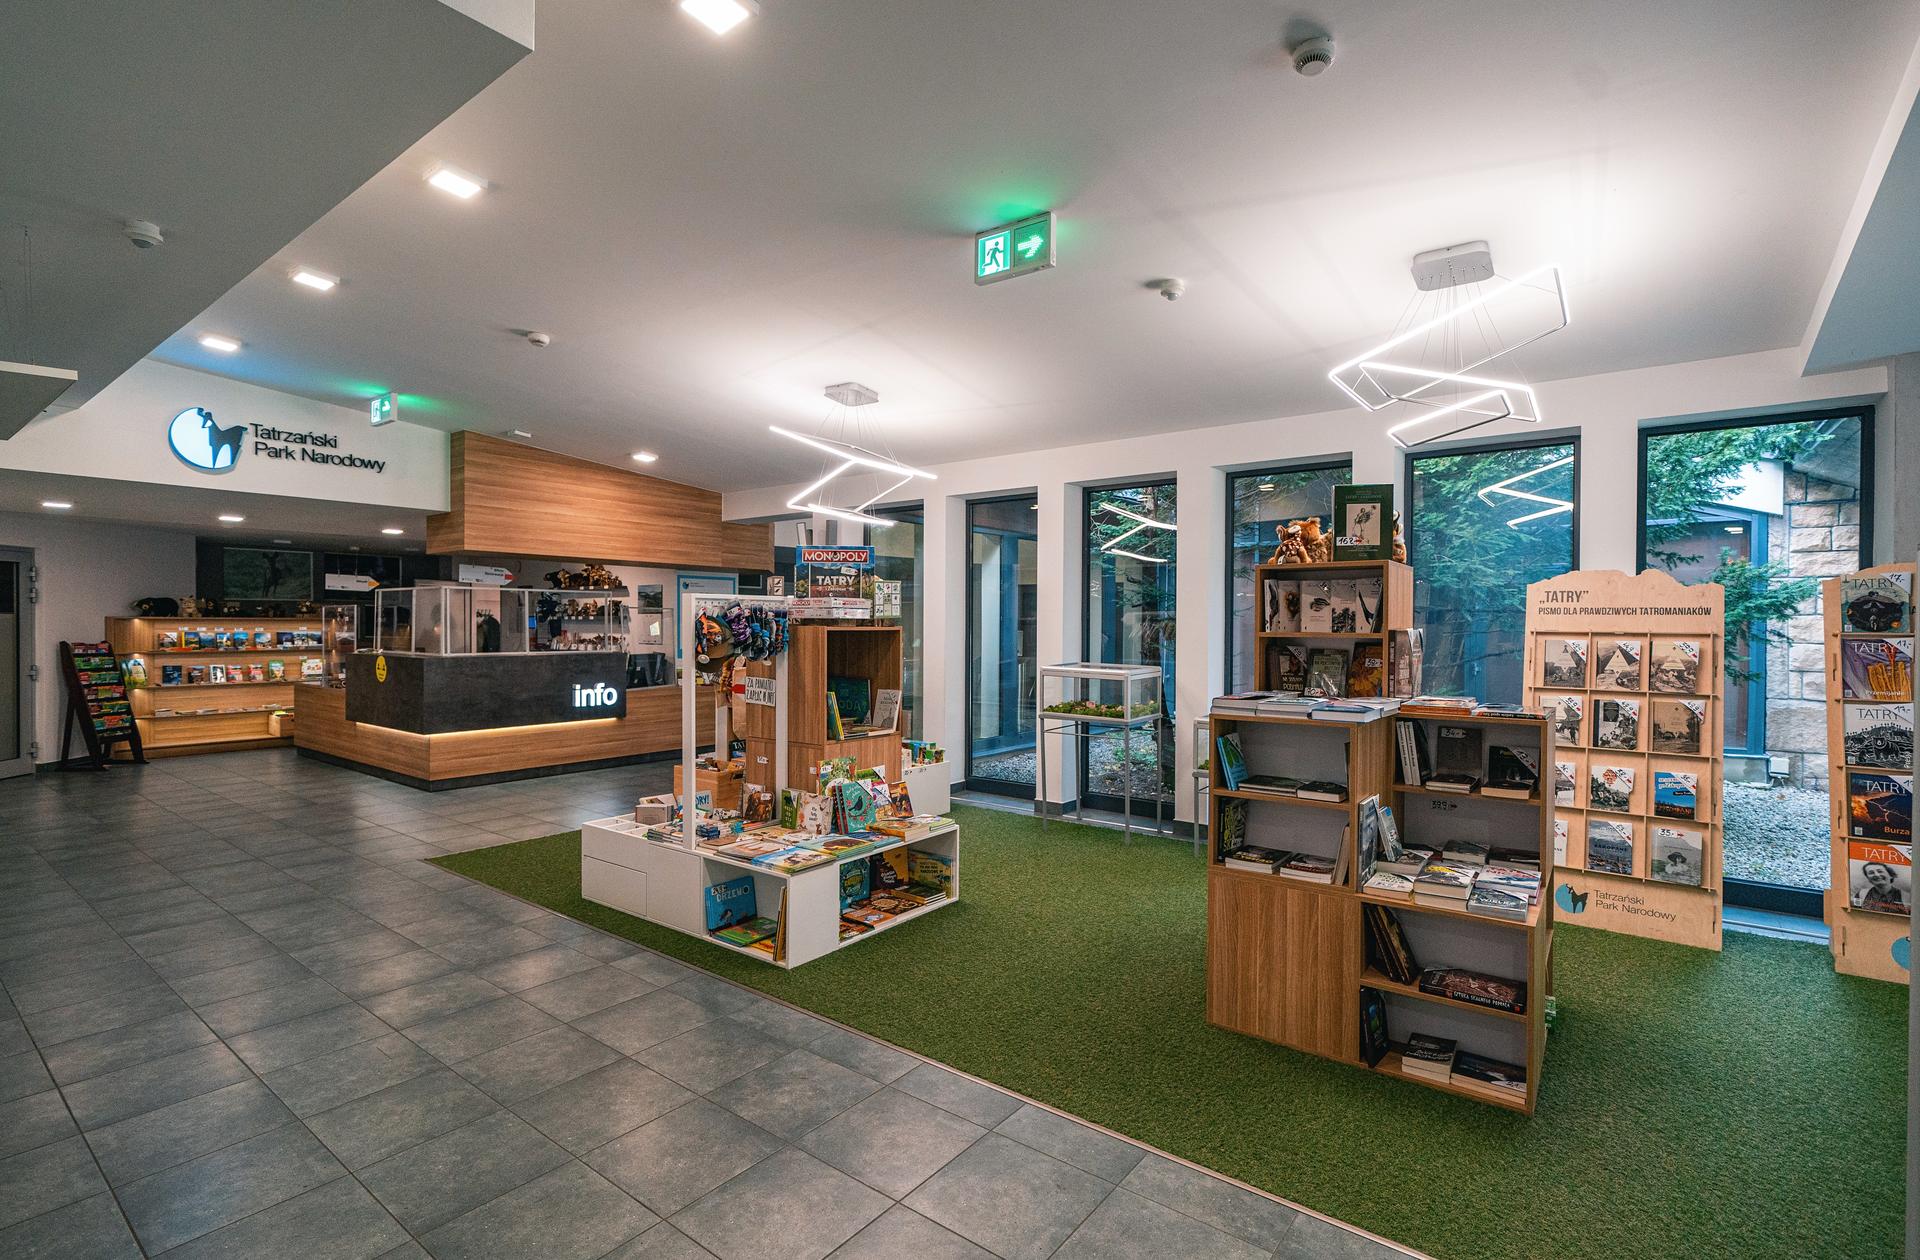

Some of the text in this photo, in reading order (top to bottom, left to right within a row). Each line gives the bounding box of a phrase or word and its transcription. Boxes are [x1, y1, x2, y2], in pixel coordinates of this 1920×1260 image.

[250, 422, 338, 448] Tatrzański
[254, 441, 386, 474] Park Narodowy
[804, 551, 867, 562] MONOPOLY
[816, 575, 855, 586] TATRY
[1852, 578, 1894, 589] TATRY
[1539, 590, 1589, 604] „TATRY”
[1538, 606, 1712, 615] PISMO DLA PRAWDZIWYCH TATROMANIAKÓW
[1852, 642, 1896, 653] TATRY
[747, 677, 753, 687] ZA
[573, 682, 618, 707] info
[1856, 708, 1900, 720] TATRY
[1863, 780, 1906, 794] TATRY
[1884, 825, 1910, 836] Burza
[1862, 847, 1907, 862] TATRY
[716, 884, 750, 902] DRZEWO
[1594, 889, 1645, 906] Tatrzański
[1595, 900, 1677, 922] Park Narodowy
